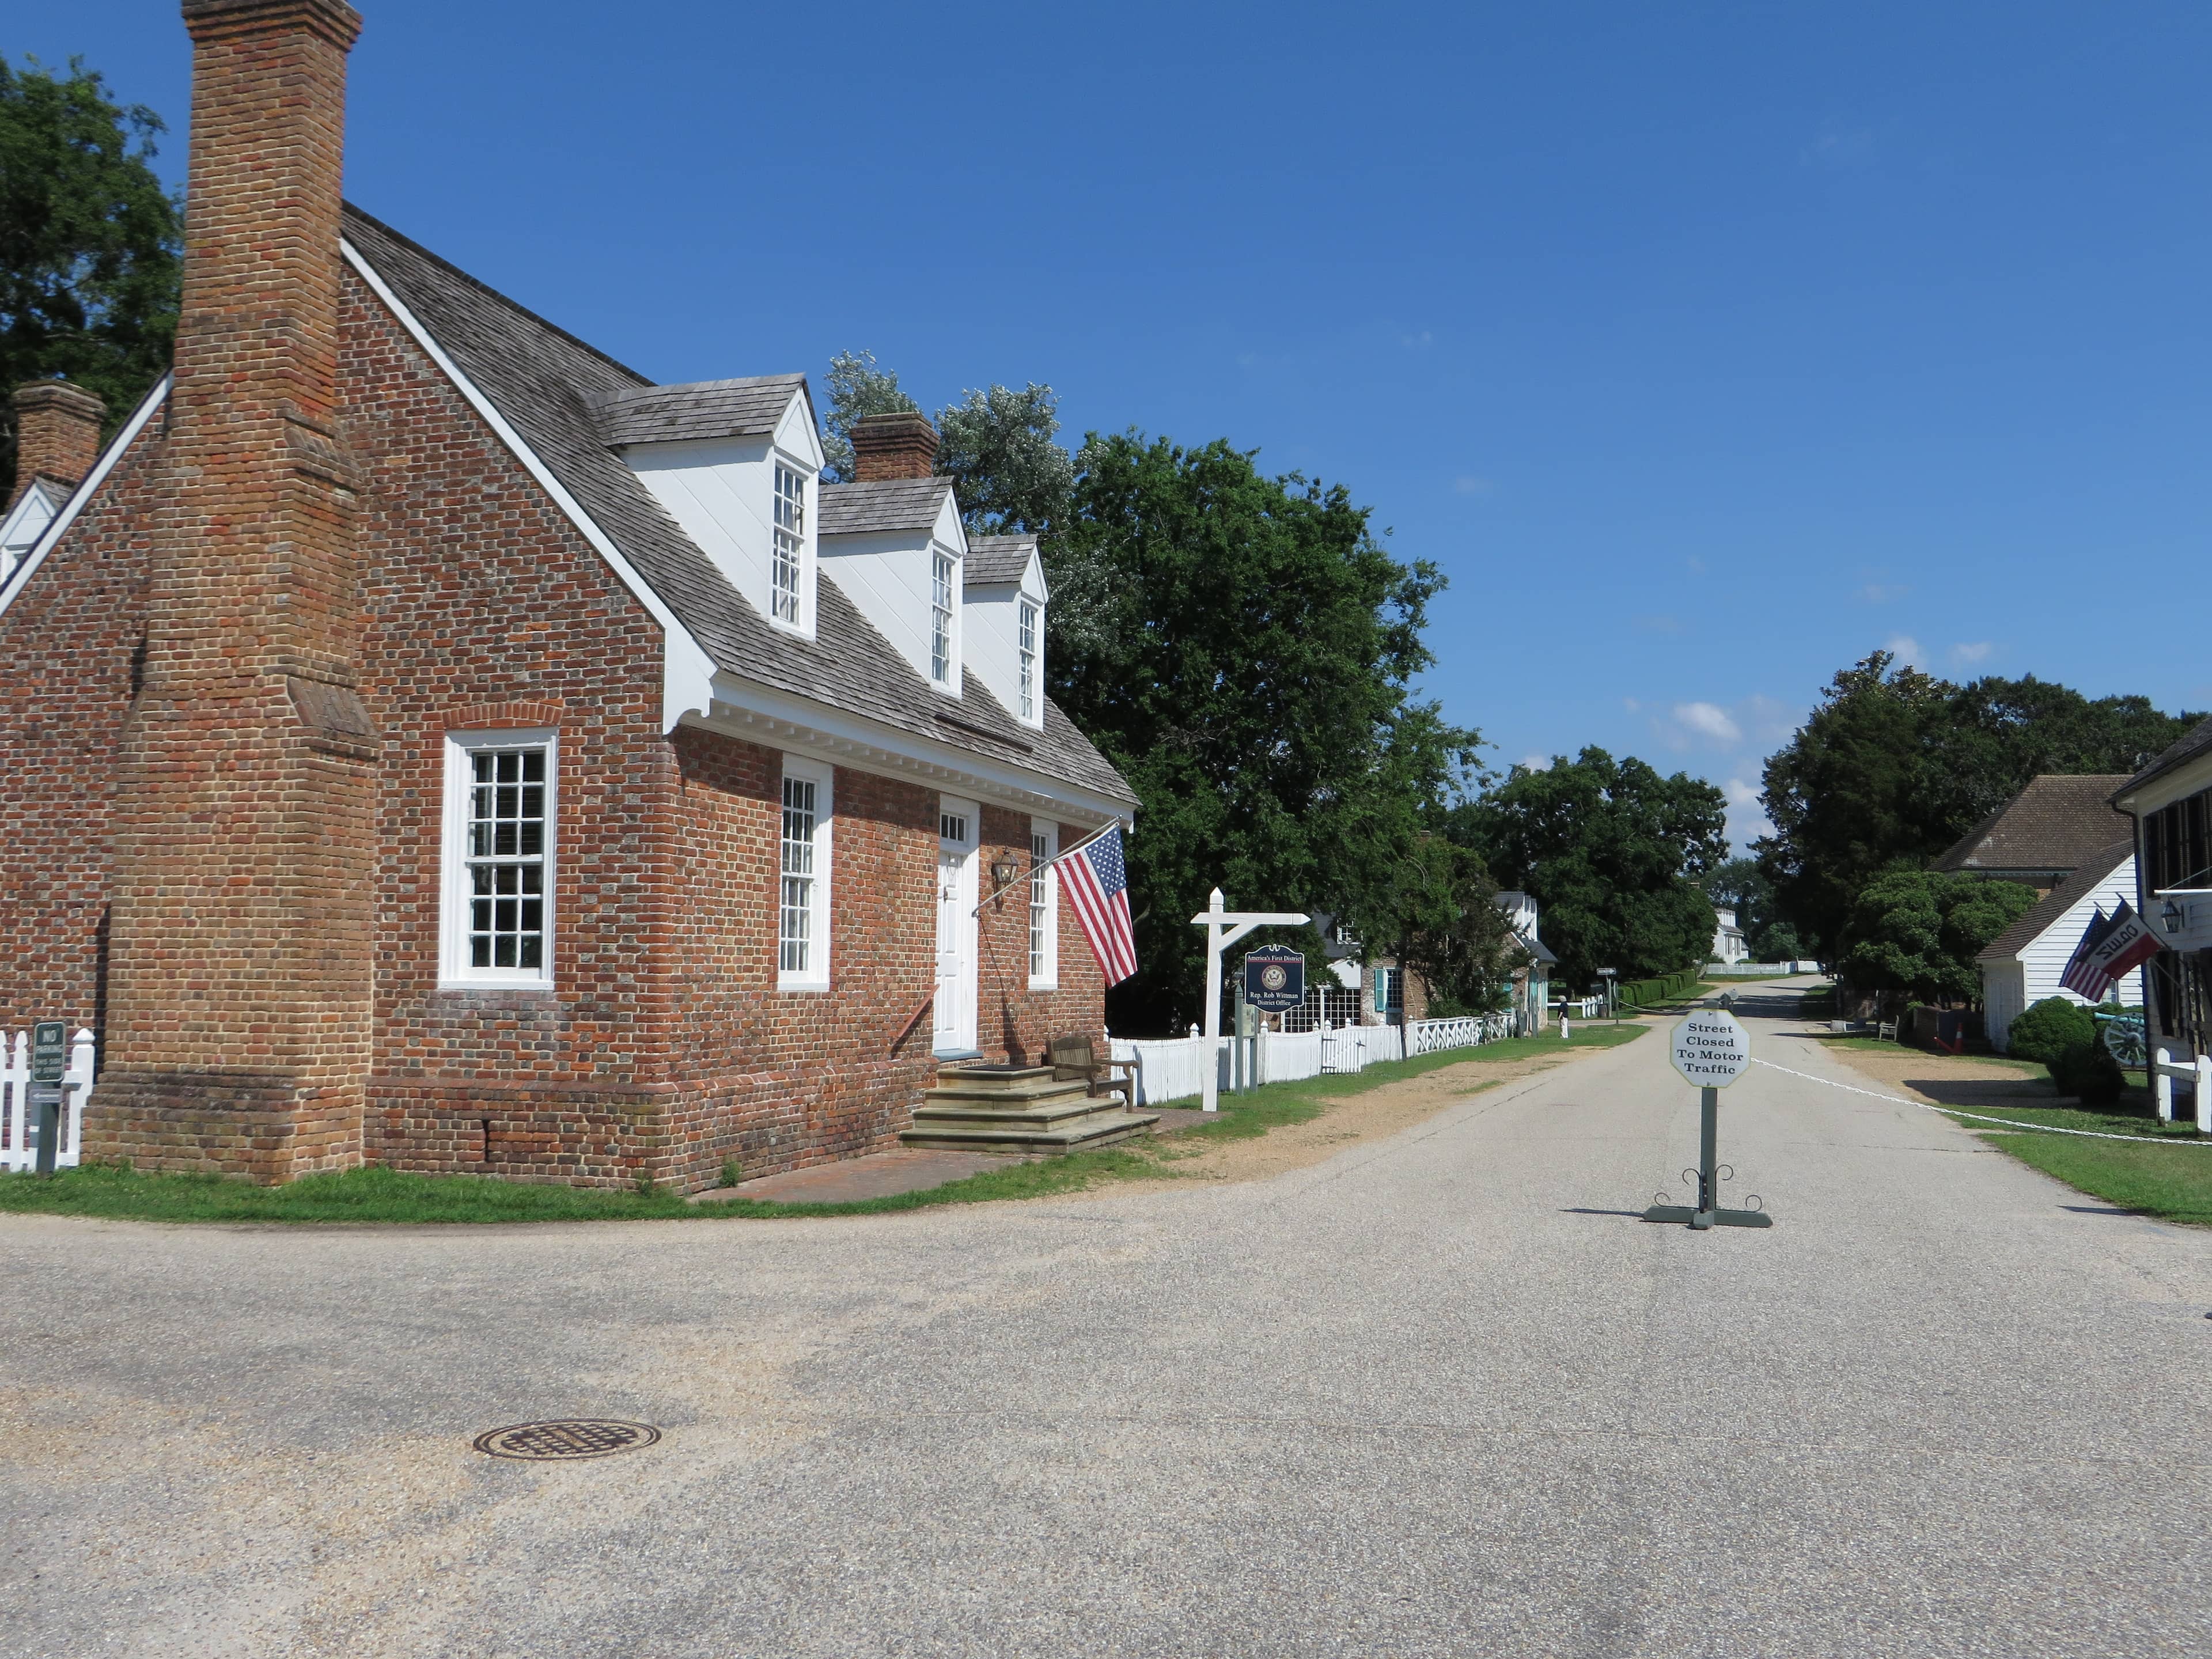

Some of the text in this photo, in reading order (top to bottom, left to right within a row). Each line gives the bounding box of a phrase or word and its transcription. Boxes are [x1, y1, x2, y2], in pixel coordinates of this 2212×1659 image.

[1688, 1023, 1733, 1033] Street
[43, 1030, 56, 1042] NO
[1686, 1036, 1734, 1047] Closed
[36, 1044, 62, 1054] PARKING
[1677, 1050, 1743, 1061] To Motor
[1684, 1063, 1736, 1074] Traffic
